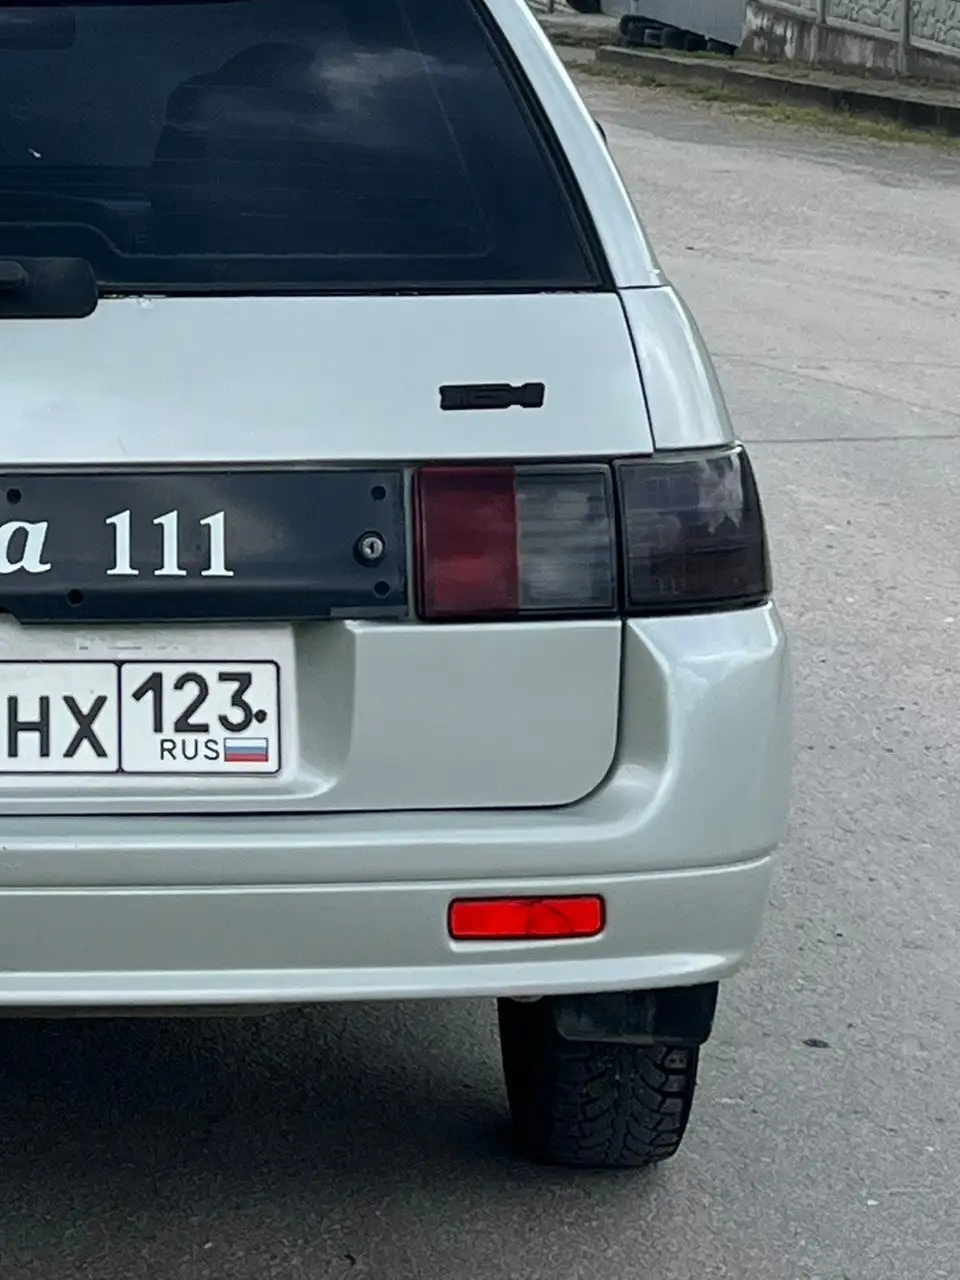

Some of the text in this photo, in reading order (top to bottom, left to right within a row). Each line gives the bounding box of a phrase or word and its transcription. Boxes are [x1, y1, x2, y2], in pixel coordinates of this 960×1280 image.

[105, 510, 235, 577] 111
[131, 672, 254, 733] 123
[160, 738, 220, 761] RUS
